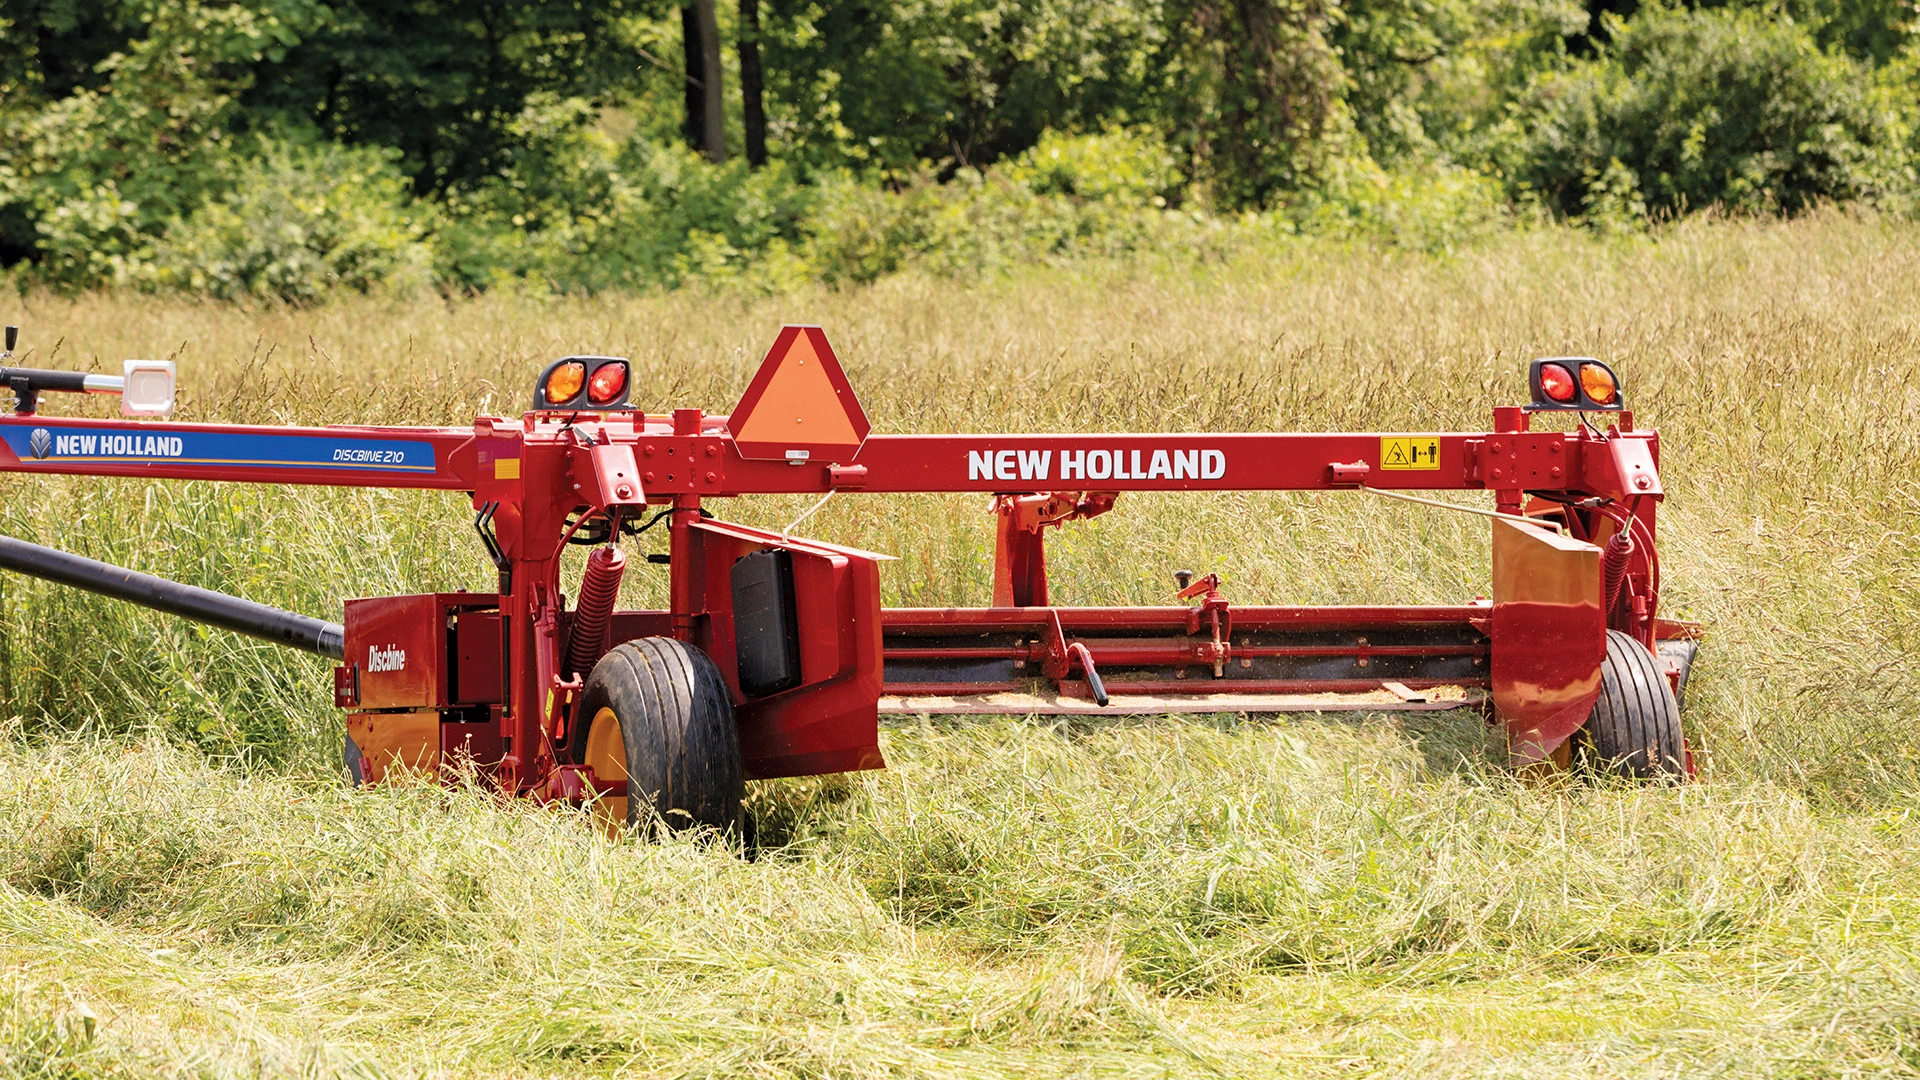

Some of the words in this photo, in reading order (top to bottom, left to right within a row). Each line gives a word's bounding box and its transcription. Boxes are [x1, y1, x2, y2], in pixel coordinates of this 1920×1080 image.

[56, 435, 97, 455] NEW
[100, 435, 183, 456] HOLLAND
[333, 449, 383, 462] DISCBINE
[383, 451, 404, 463] 210
[968, 450, 1051, 480] NEW
[1060, 449, 1226, 480] HOLLAND
[368, 643, 405, 673] Discbine
